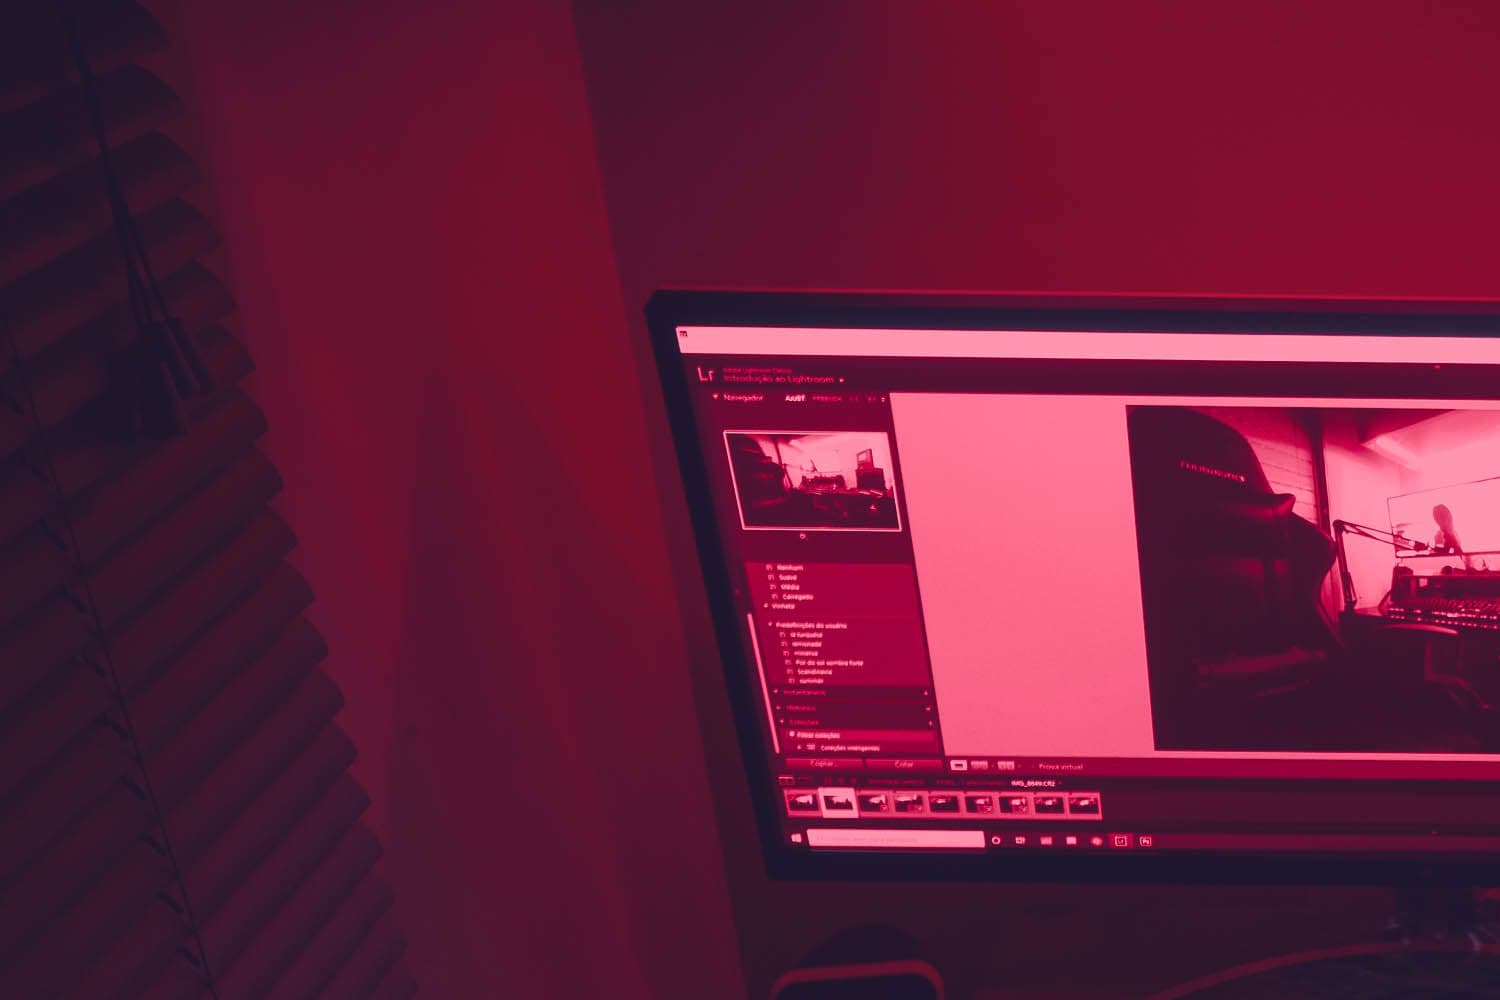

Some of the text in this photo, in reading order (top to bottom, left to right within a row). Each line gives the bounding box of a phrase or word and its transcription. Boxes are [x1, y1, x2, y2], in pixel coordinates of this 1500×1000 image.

[697, 366, 716, 382] Lr
[788, 375, 835, 385] Lightroom
[723, 393, 764, 403] Navegador
